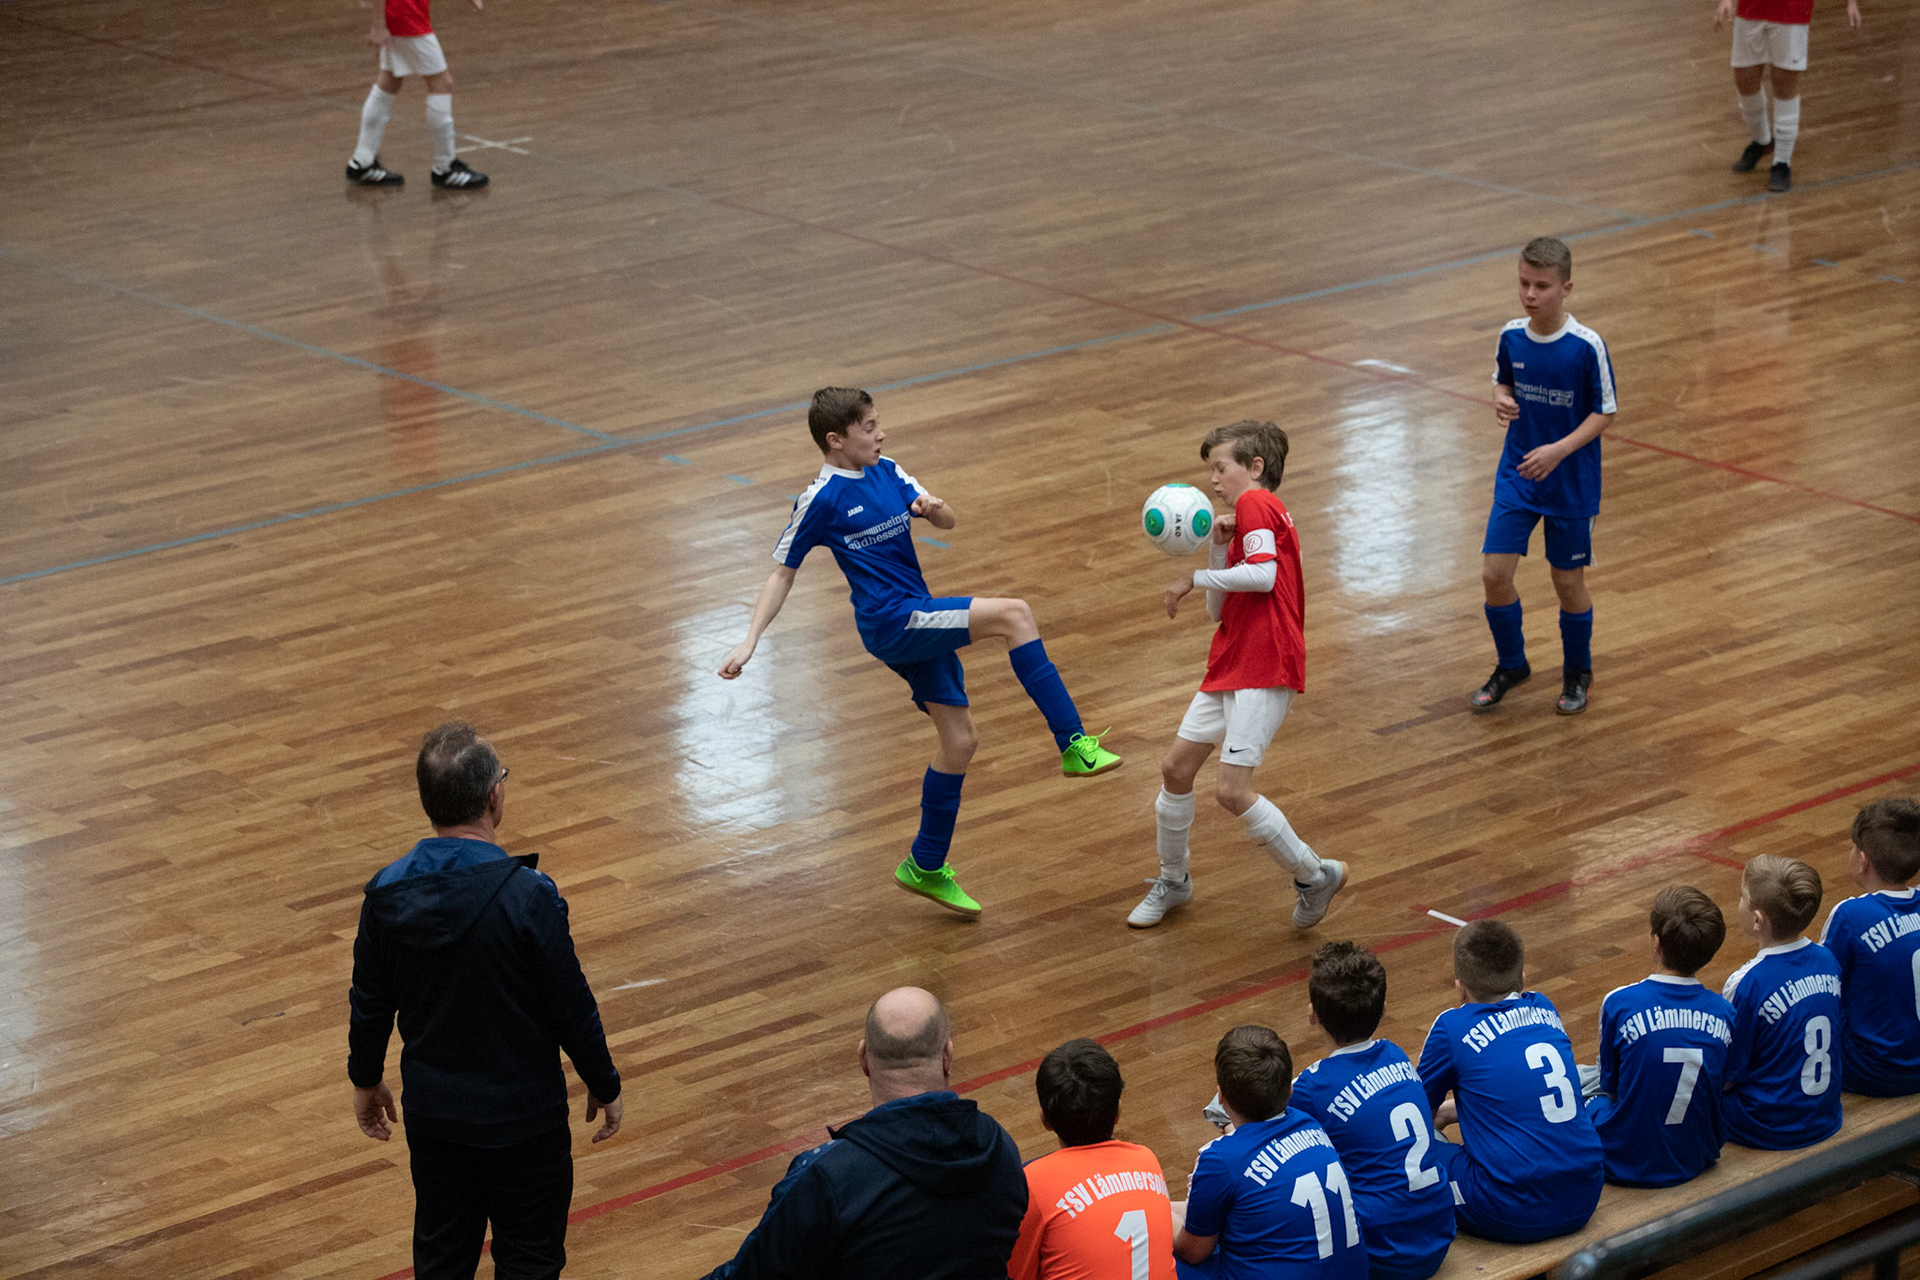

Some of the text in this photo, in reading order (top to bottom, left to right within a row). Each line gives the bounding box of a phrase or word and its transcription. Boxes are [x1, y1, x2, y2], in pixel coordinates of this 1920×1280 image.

[1860, 912, 1920, 954] TSV Lämm
[1619, 1012, 1648, 1045] TSV
[1758, 992, 1788, 1025] TSV
[1462, 1020, 1496, 1054] TSV
[1800, 1015, 1832, 1096] 8
[1326, 1085, 1362, 1123] TSV
[1524, 1042, 1578, 1124] 3
[1662, 1047, 1704, 1126] 7
[1389, 1102, 1440, 1192] 2
[1243, 1150, 1280, 1187] TSV
[1055, 1182, 1094, 1218] TSV
[1290, 1161, 1360, 1260] 11
[1113, 1209, 1149, 1280] 1
